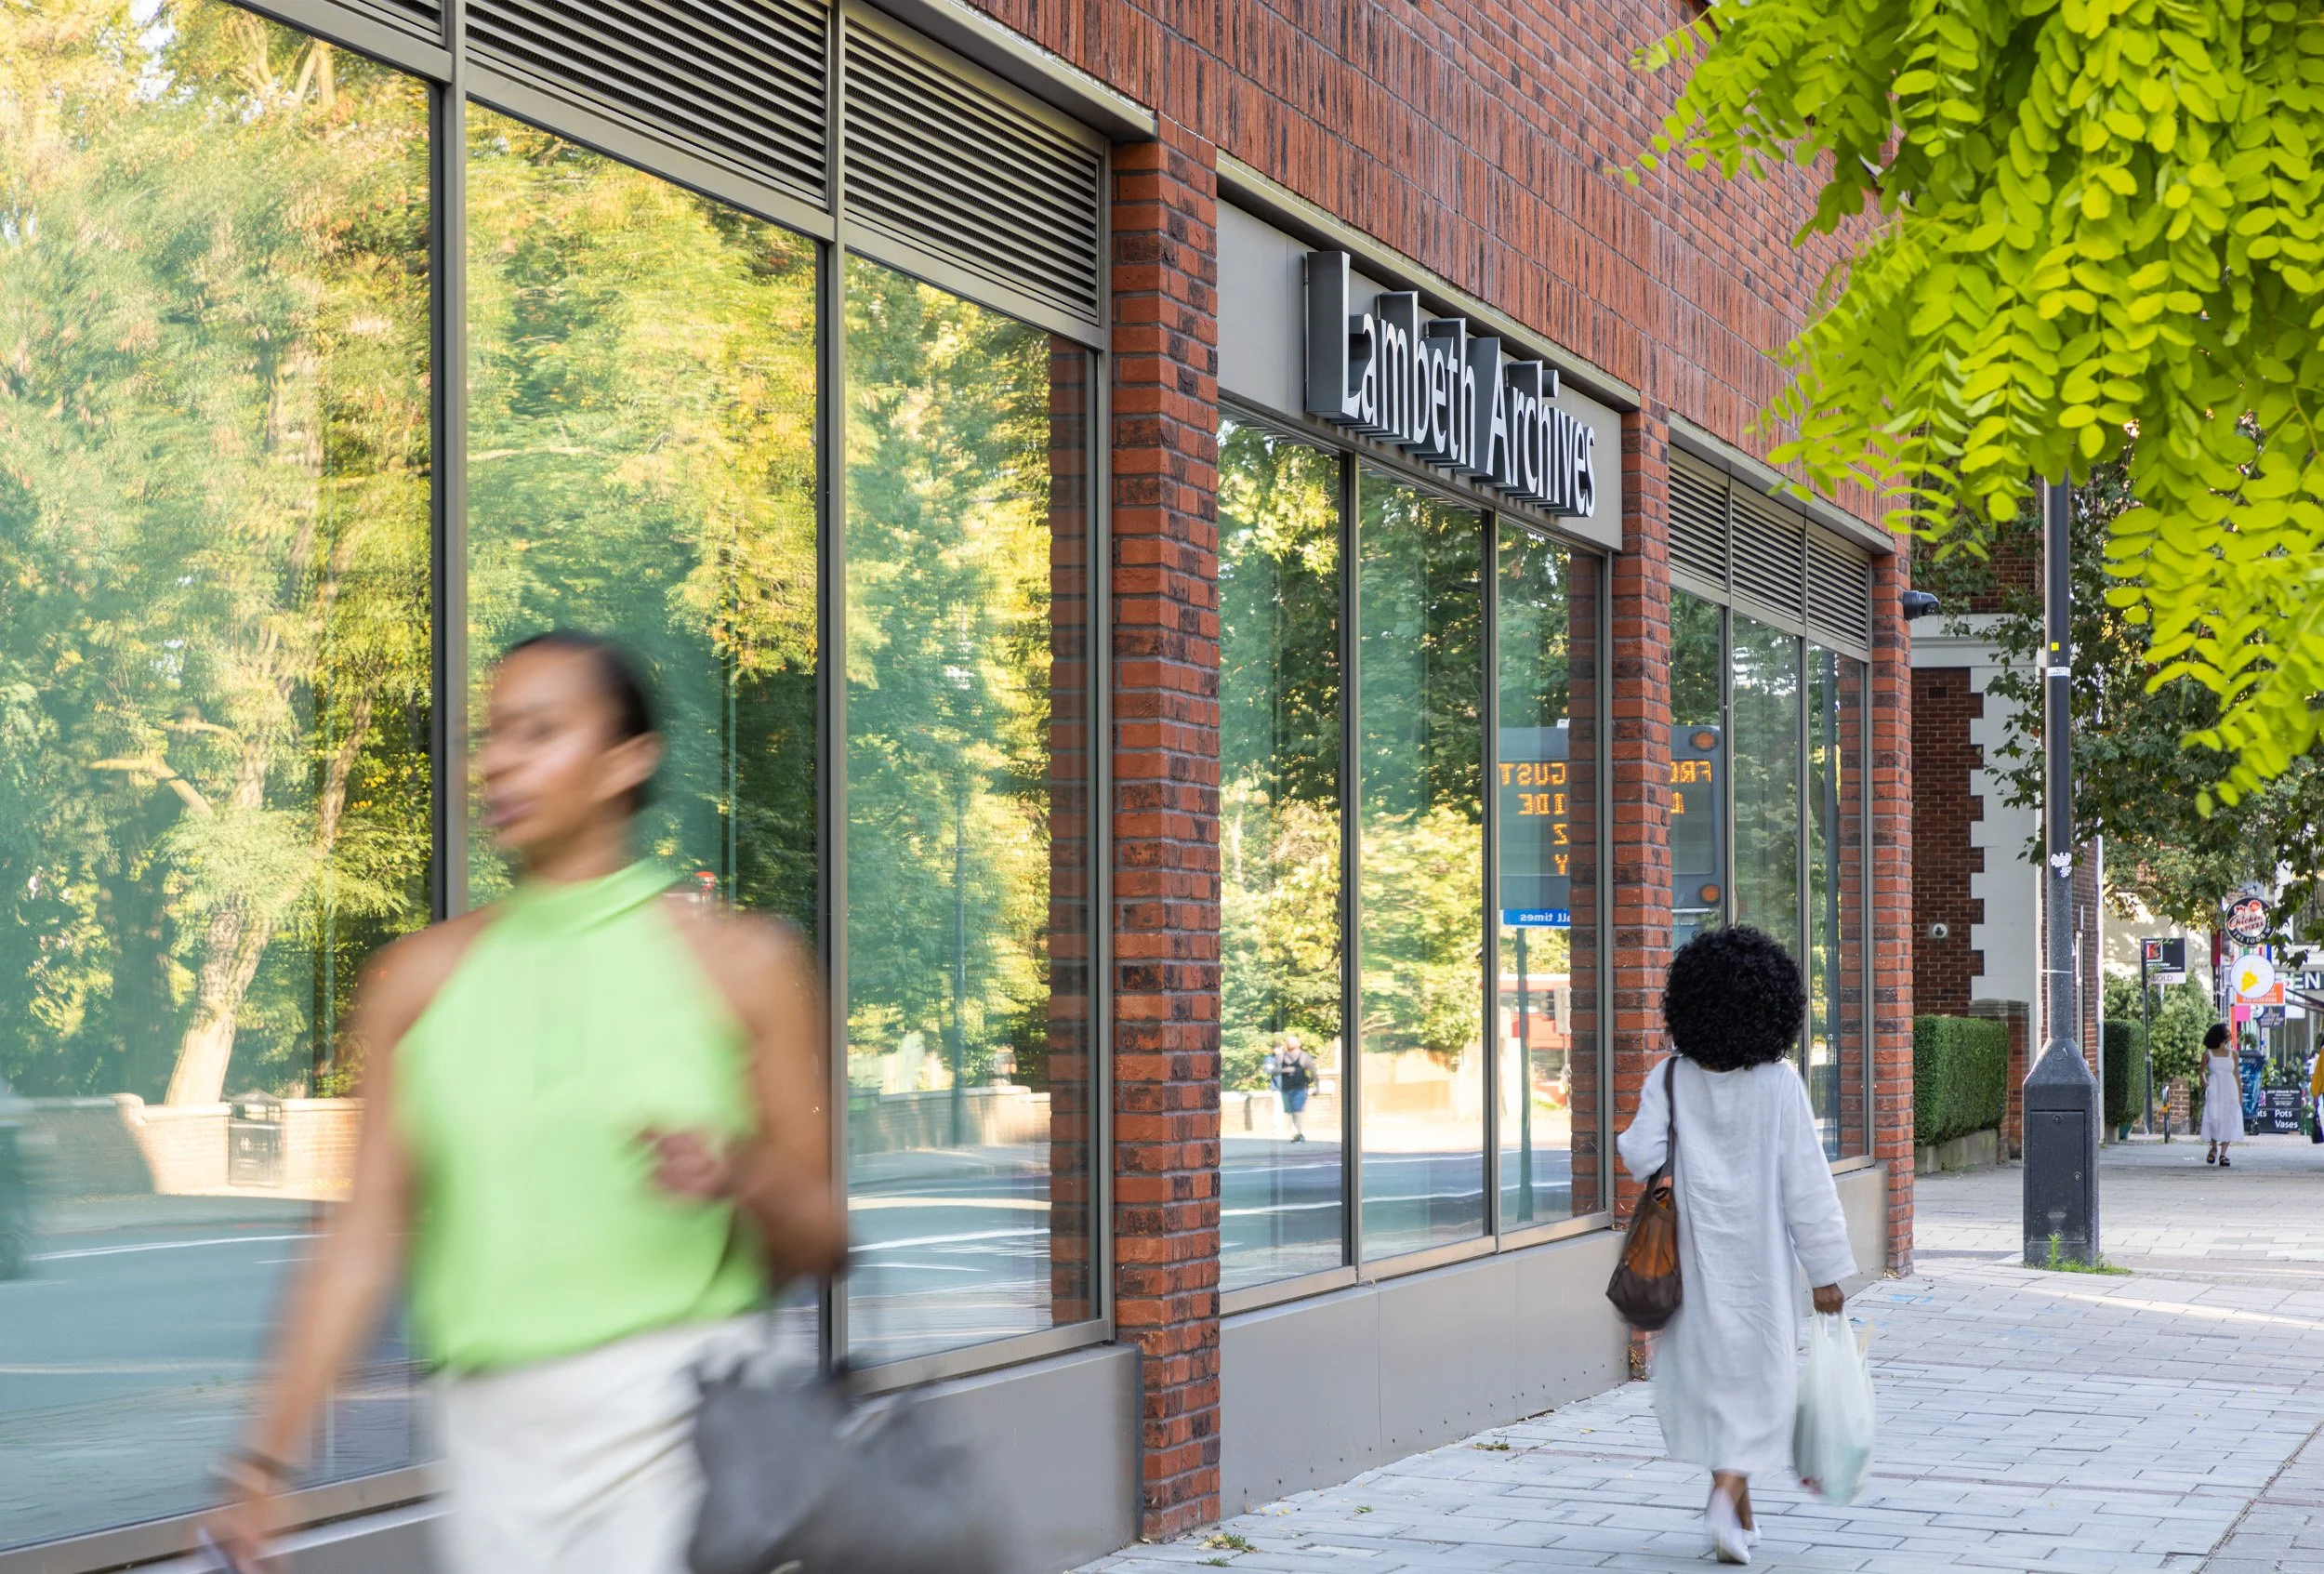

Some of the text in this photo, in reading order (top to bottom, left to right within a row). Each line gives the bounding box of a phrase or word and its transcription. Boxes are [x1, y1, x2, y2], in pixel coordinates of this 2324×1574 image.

[1340, 250, 1596, 519] Lambeth Archives
[2228, 914, 2264, 929] Chicken
[2245, 921, 2265, 932] PIZZA
[2152, 974, 2173, 983] SOLD
[2274, 1109, 2292, 1118] Pots
